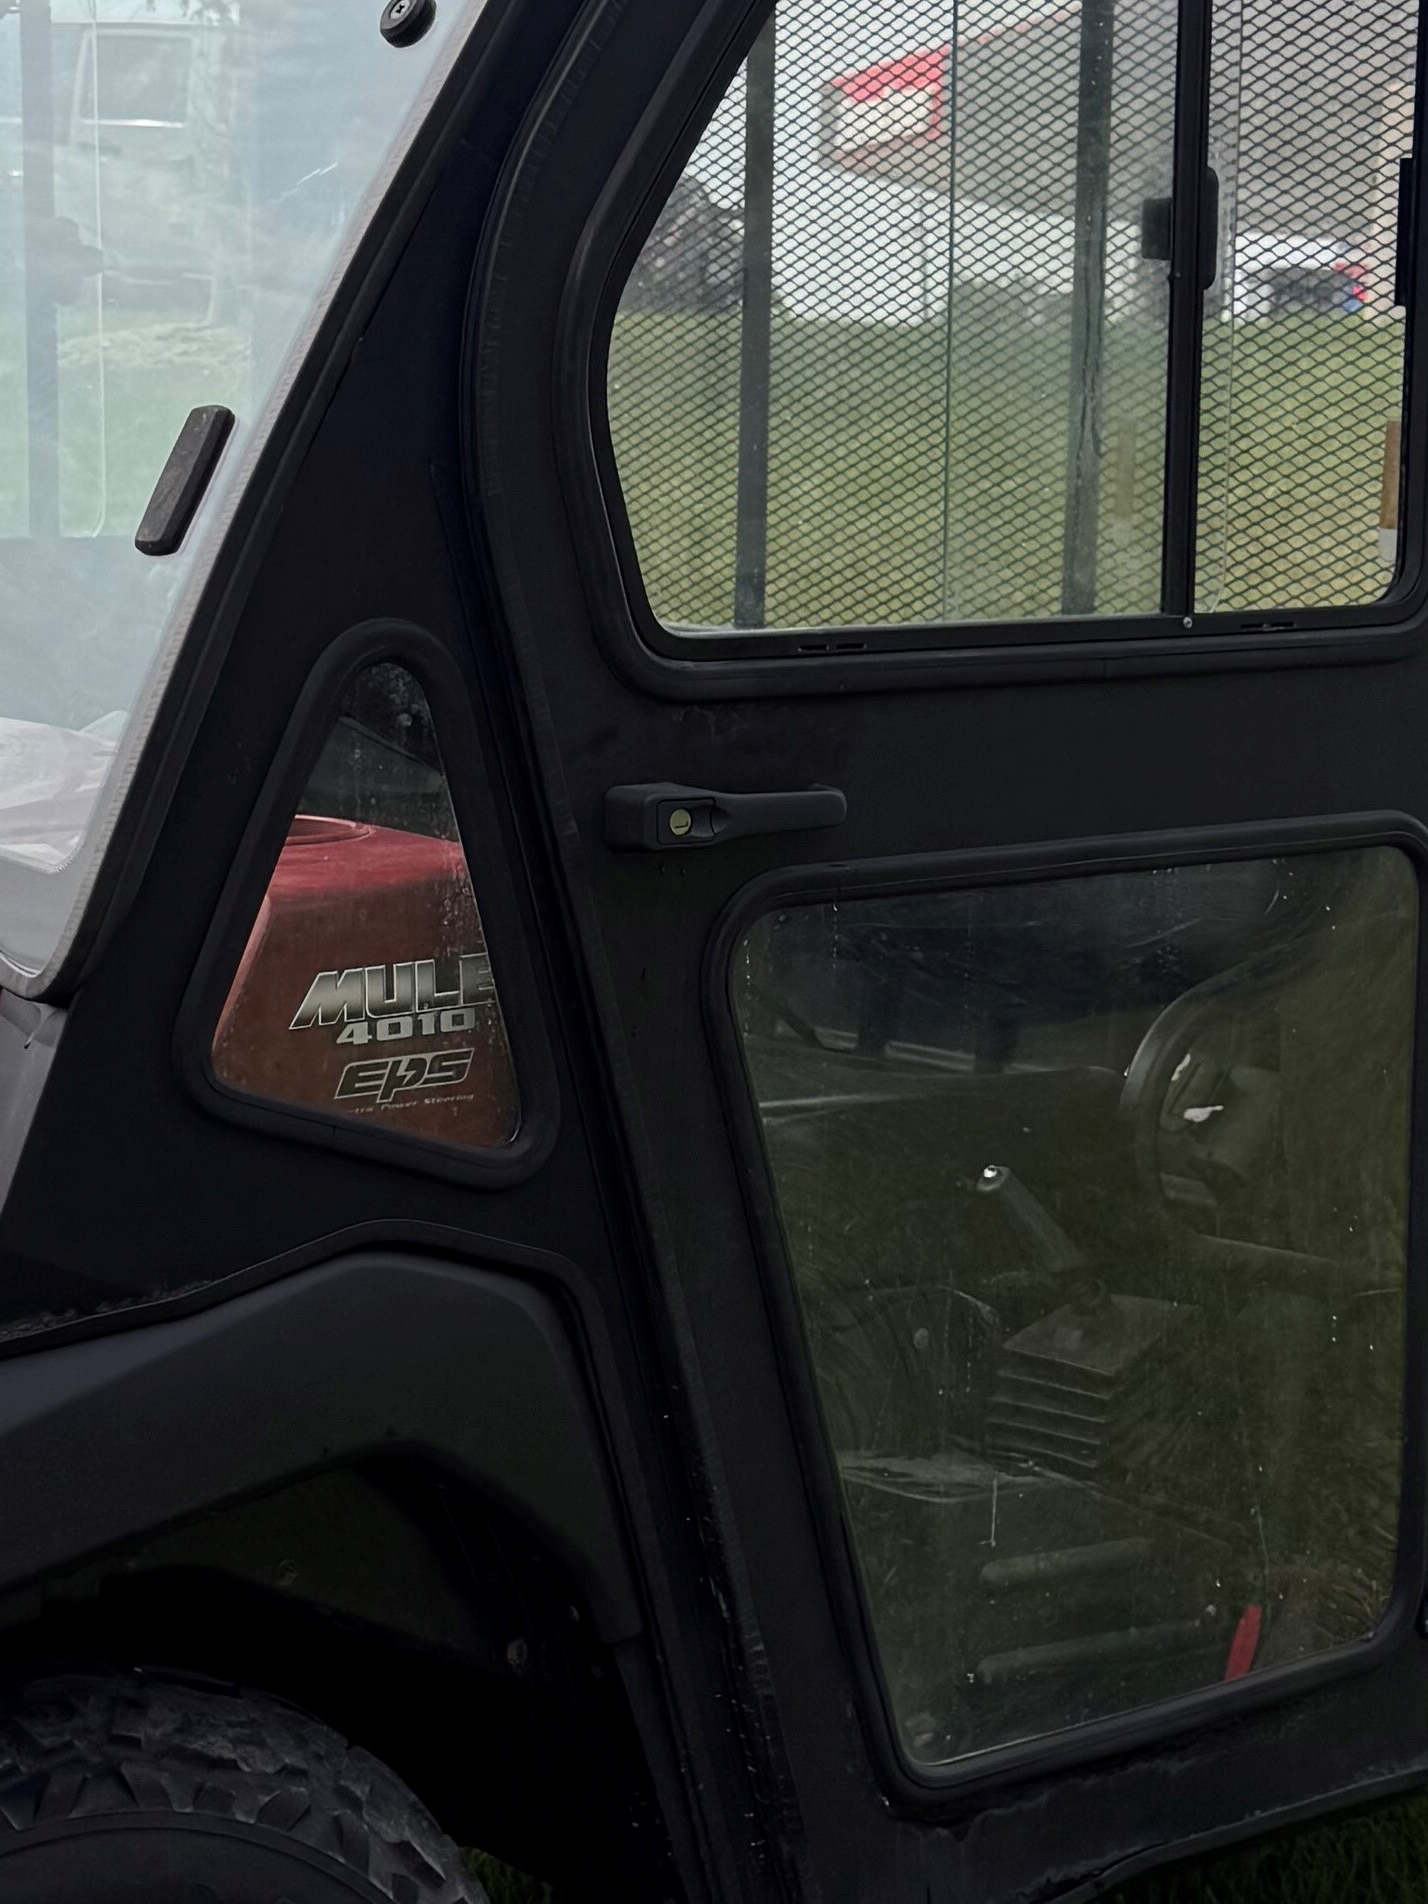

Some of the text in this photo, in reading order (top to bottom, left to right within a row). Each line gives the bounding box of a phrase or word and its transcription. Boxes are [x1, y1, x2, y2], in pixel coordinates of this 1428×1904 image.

[289, 953, 496, 1030] MULE
[336, 1008, 476, 1045] 4010
[334, 1048, 475, 1103] EPS
